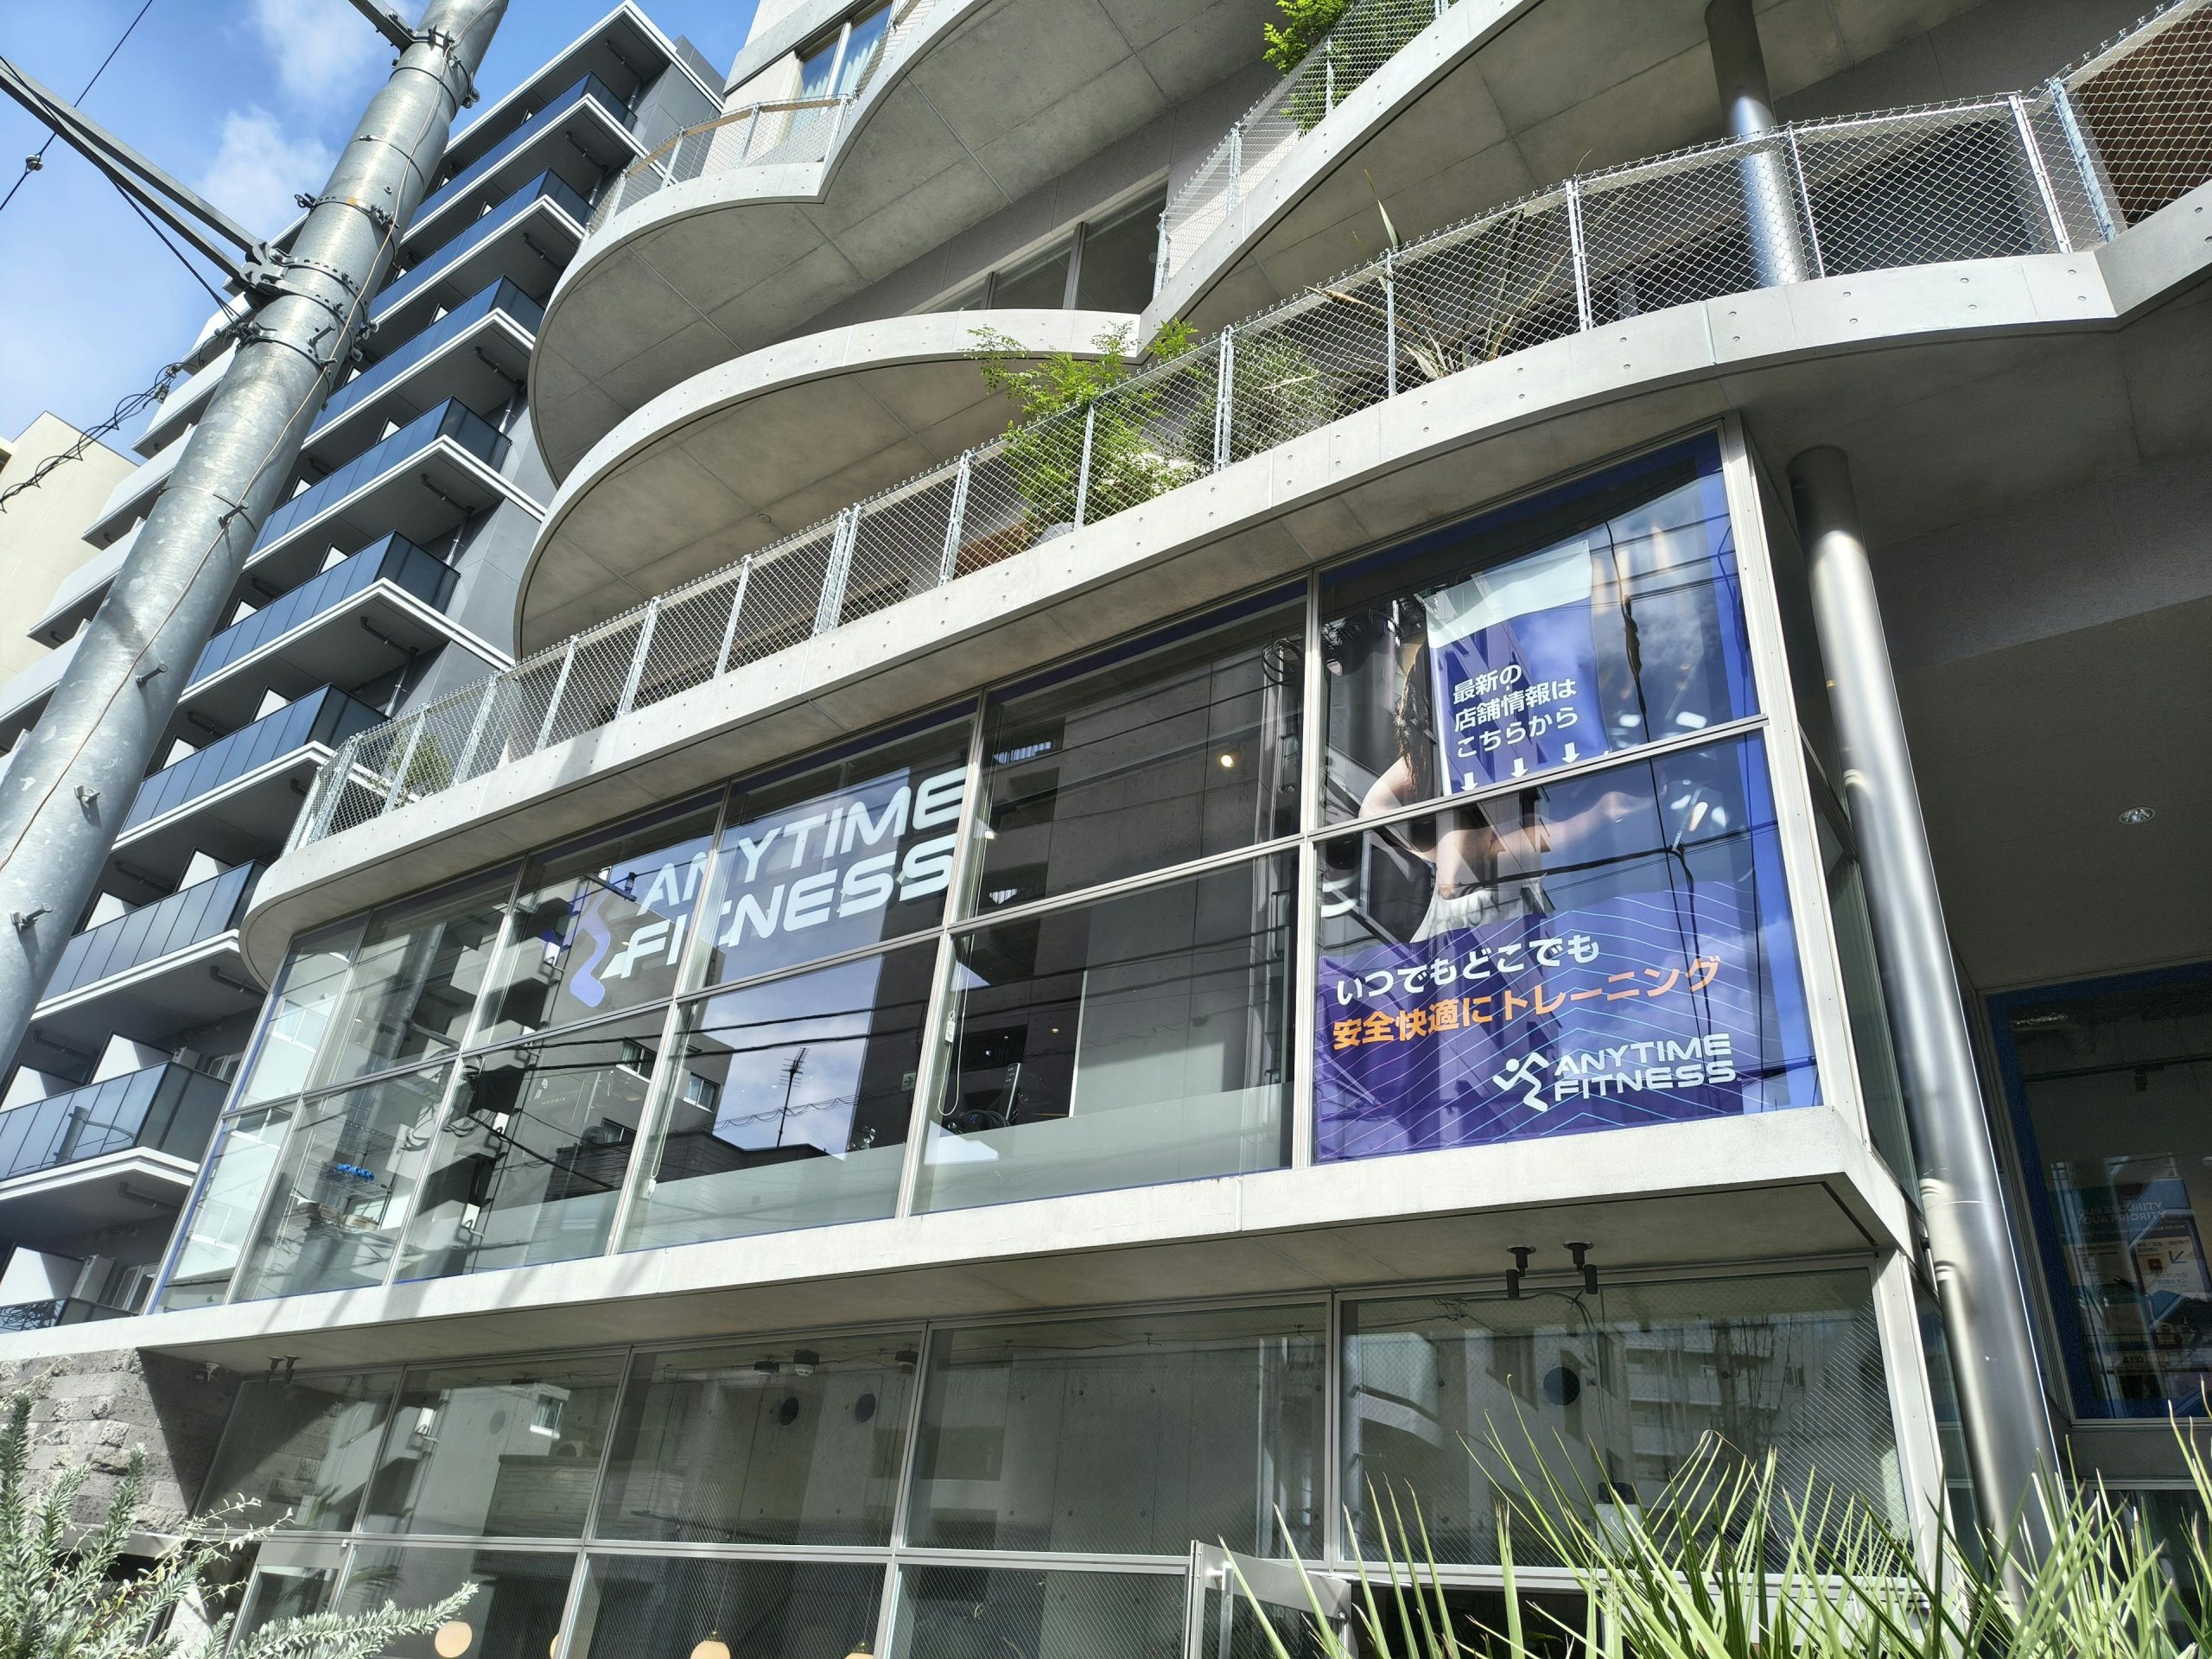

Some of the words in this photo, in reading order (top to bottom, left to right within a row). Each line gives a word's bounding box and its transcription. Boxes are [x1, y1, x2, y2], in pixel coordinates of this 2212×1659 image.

[1452, 664, 1522, 704] 最新の
[1454, 678, 1577, 733] 店舗情報は
[1457, 707, 1579, 758] こちらから
[620, 832, 958, 979] FINESS
[1337, 934, 1599, 1006] いつでもどこでも
[1332, 956, 1721, 1051] 安全快適にトレーニング
[1554, 1033, 1732, 1077] ANYTIME
[1554, 1060, 1736, 1102] FITNESS
